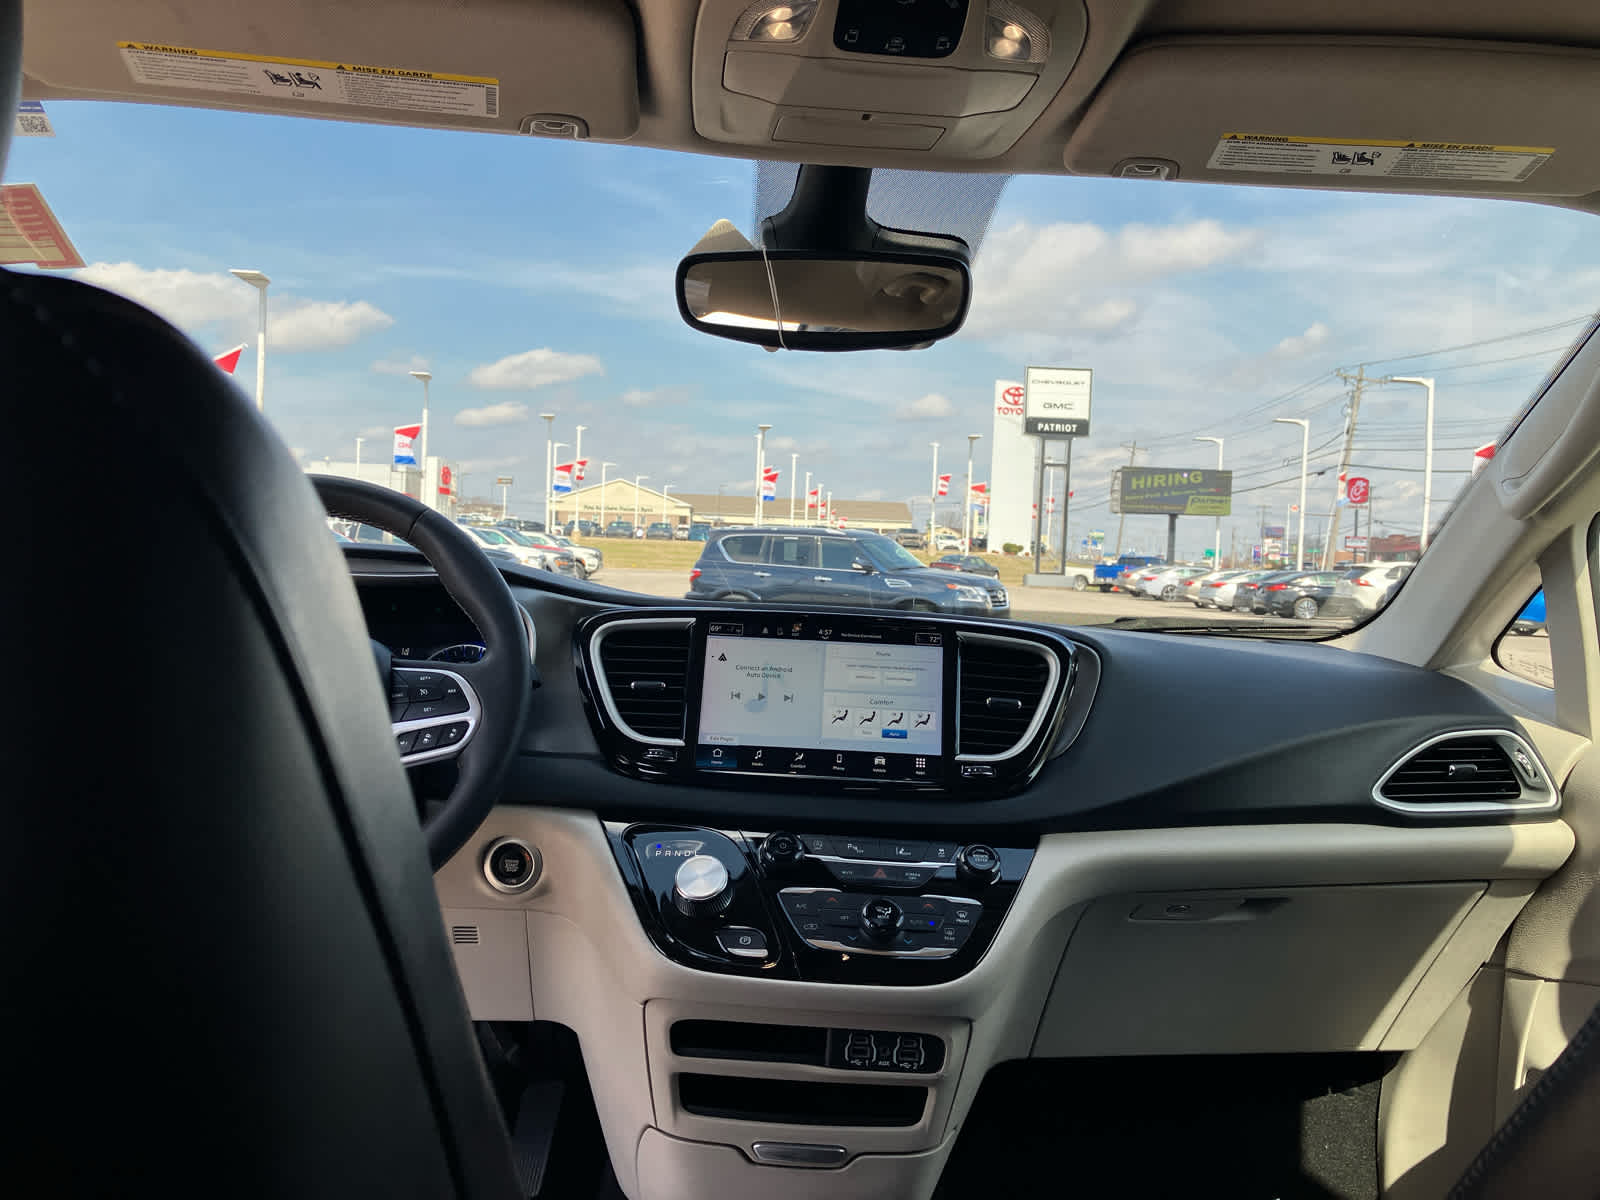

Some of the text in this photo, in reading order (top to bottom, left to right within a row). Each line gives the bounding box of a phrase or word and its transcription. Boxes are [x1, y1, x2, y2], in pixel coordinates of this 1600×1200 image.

[143, 44, 198, 55] WARNING
[352, 66, 378, 74] MISE
[397, 70, 433, 79] GARDE
[1243, 134, 1289, 143] WARNING
[997, 406, 1024, 416] TOYO
[1043, 402, 1074, 410] GMC
[1037, 422, 1078, 433] PATRIOT
[1131, 471, 1203, 490] HIRING
